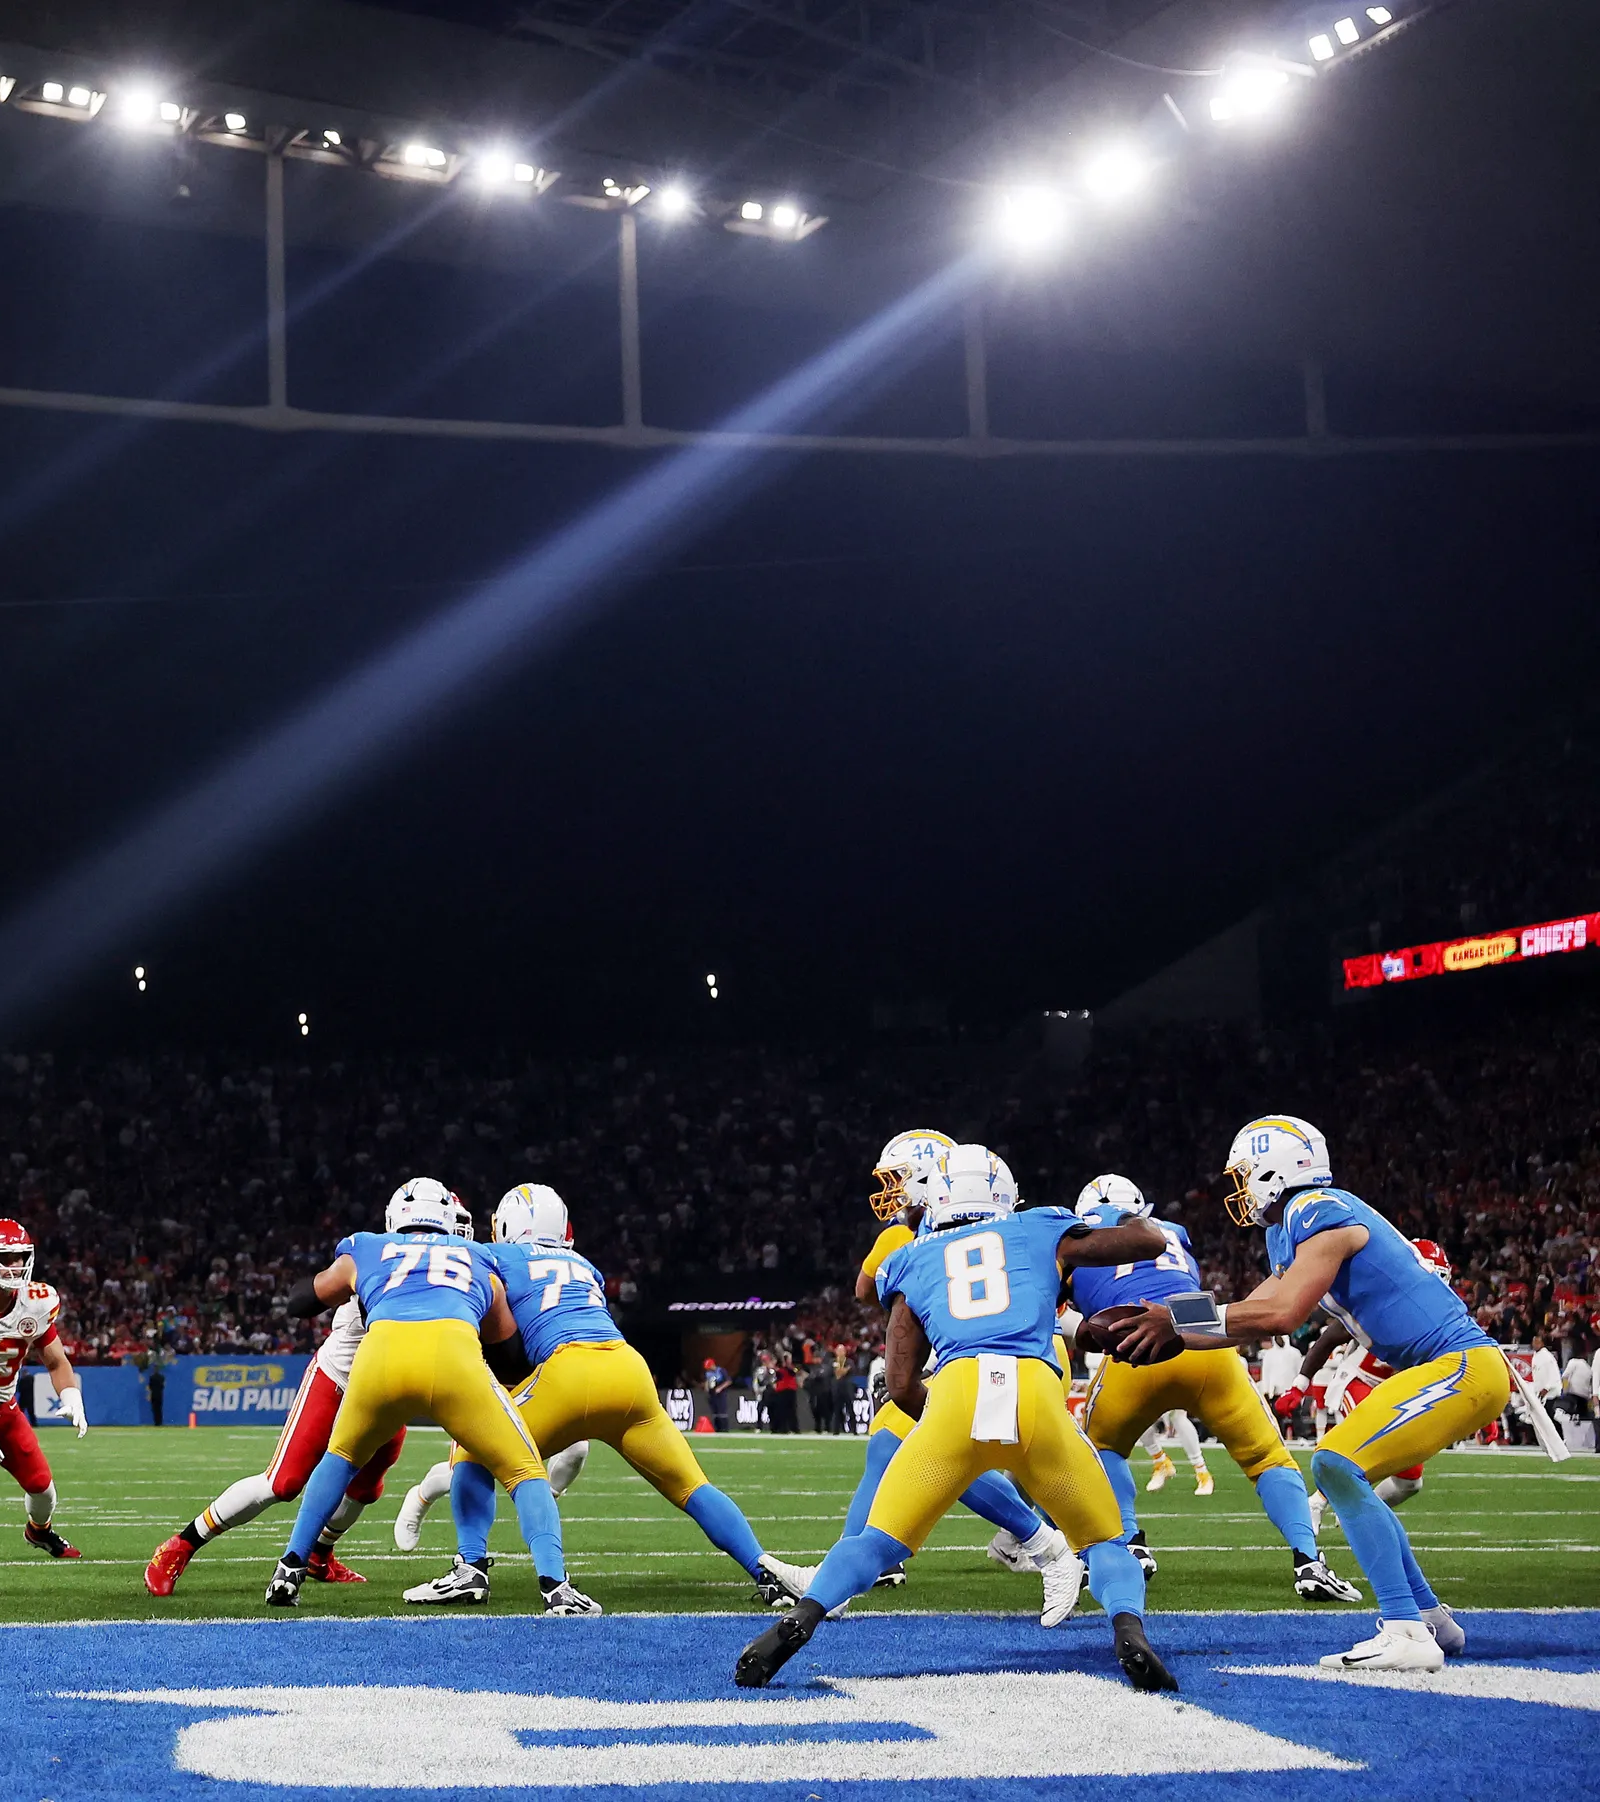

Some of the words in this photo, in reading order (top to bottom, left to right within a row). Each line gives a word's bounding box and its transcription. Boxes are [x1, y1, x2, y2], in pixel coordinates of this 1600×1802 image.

[1452, 946, 1484, 962] KANSAS
[1487, 941, 1506, 956] CITY
[1521, 919, 1587, 956] CHIEFS
[912, 1142, 935, 1160] 44
[1251, 1133, 1270, 1156] 10
[951, 1211, 996, 1220] CHARGERS
[411, 1233, 442, 1243] ALT
[381, 1242, 472, 1294] 76
[943, 1231, 1010, 1320] 8
[528, 1260, 605, 1312] 77
